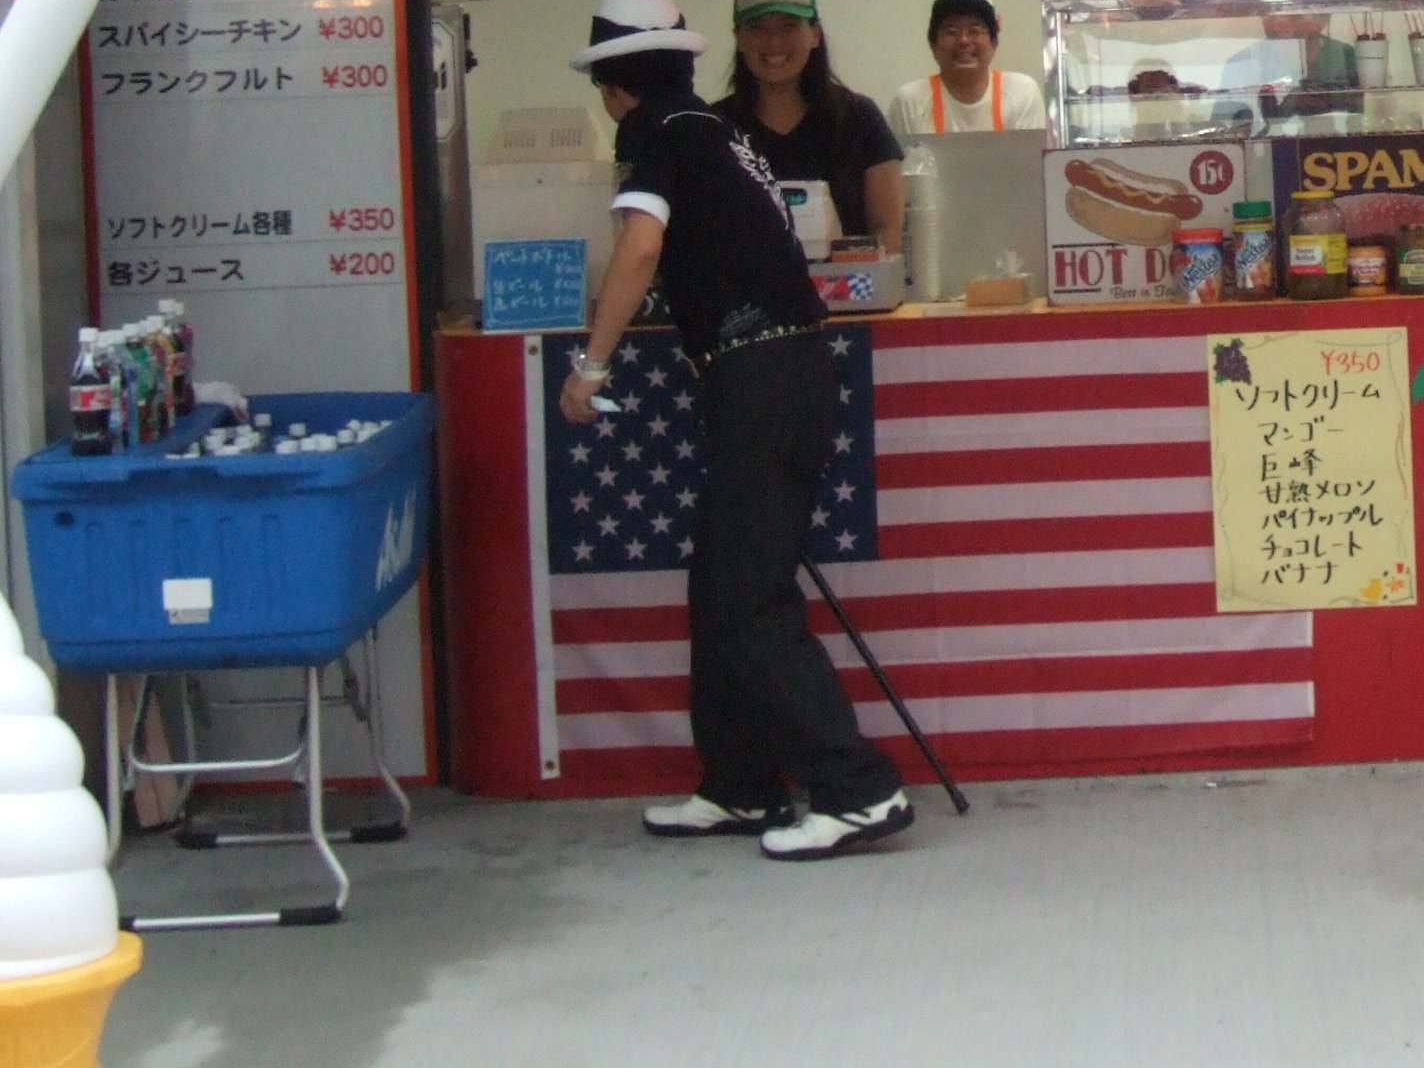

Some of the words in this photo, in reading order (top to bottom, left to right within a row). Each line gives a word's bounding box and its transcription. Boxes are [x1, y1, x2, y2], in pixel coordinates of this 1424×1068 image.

[97, 18, 304, 49] スパイシーチキン
[318, 14, 386, 41] ¥300
[100, 65, 295, 96] フランクフルト
[322, 63, 390, 89] ¥300
[106, 208, 294, 241] ソフトクリーム各種
[328, 206, 395, 233] ¥350
[106, 257, 246, 288] 各ジュース
[329, 250, 396, 278] ¥200
[1054, 247, 1128, 288] HOT
[1320, 349, 1381, 377] ¥350
[1235, 379, 1381, 412] ソフトクリーム
[1257, 415, 1345, 447] マンゴー
[1260, 448, 1324, 483] 巨峰
[1262, 503, 1384, 531] パイナップル
[1261, 530, 1363, 561] チョコレート
[1261, 560, 1339, 585] バナナ
